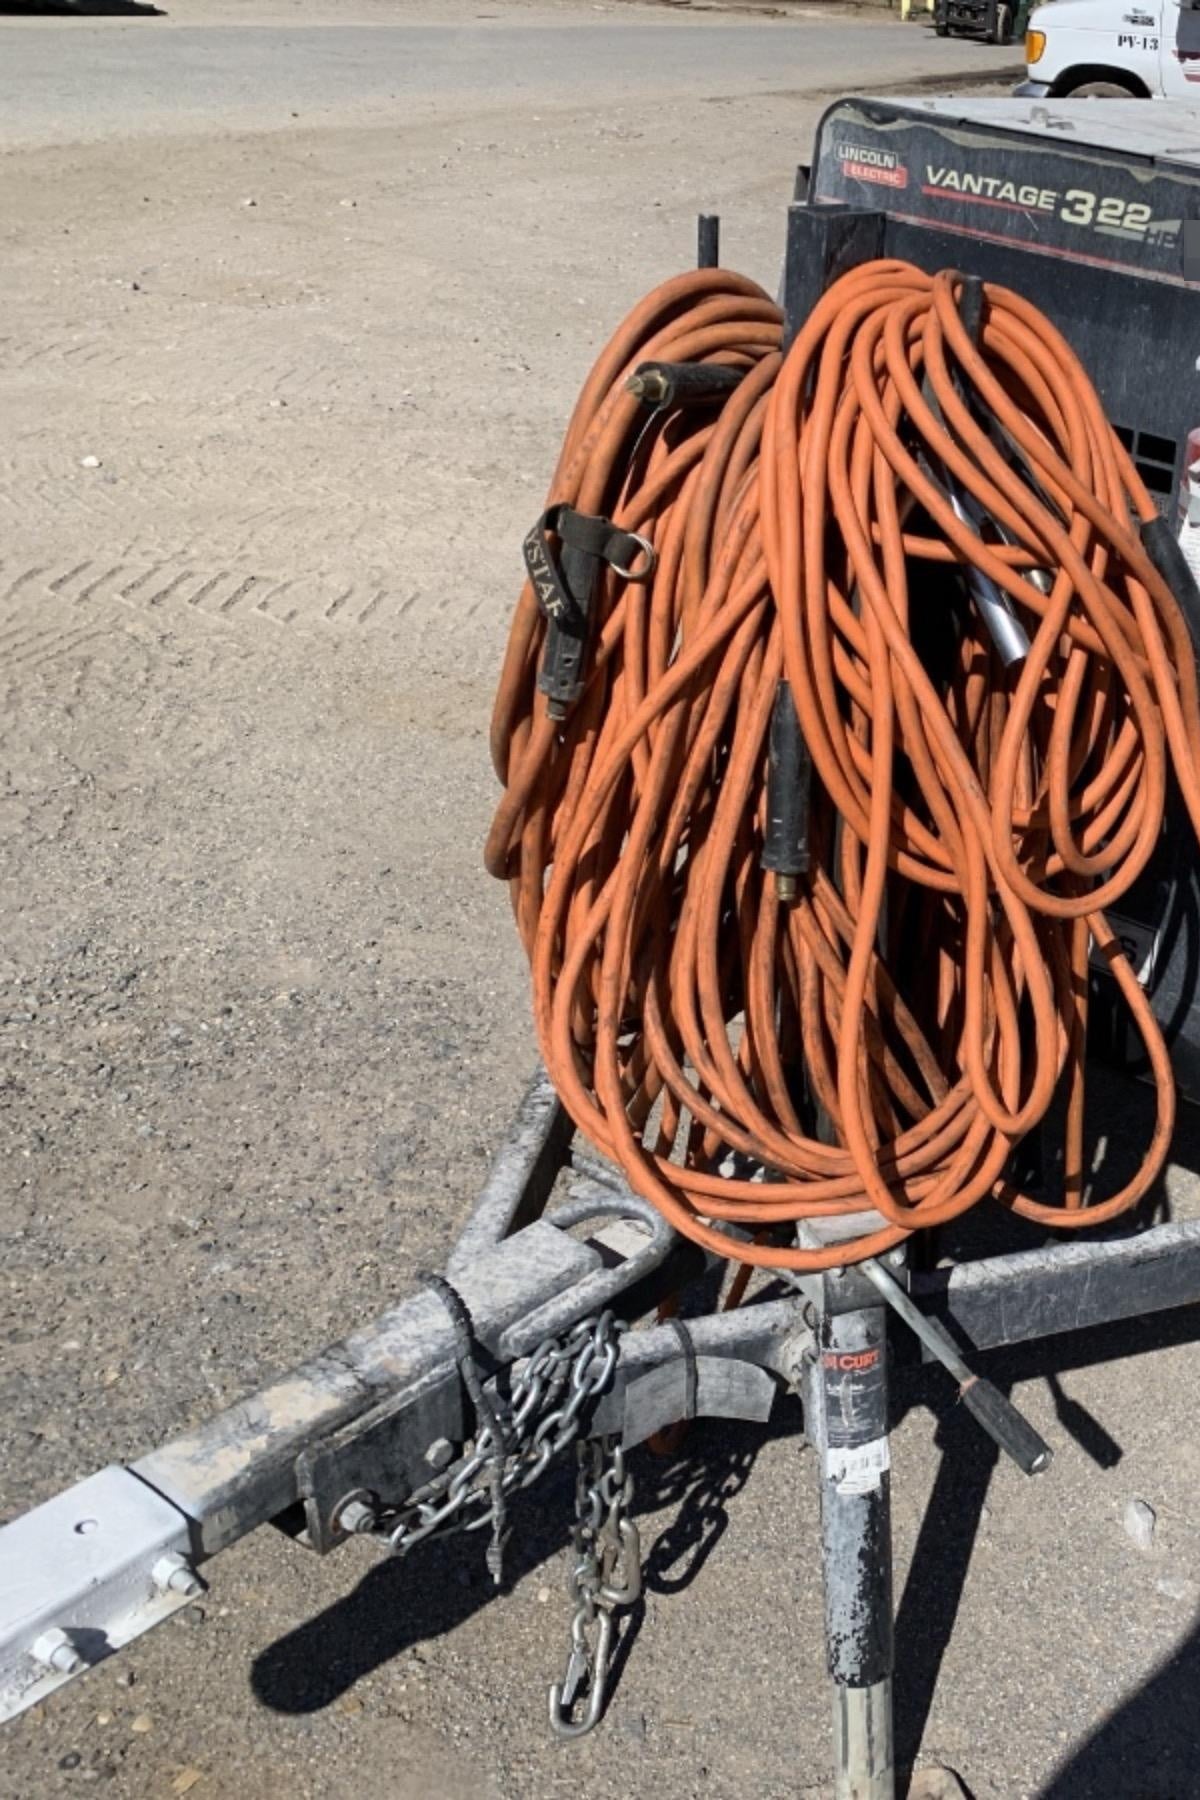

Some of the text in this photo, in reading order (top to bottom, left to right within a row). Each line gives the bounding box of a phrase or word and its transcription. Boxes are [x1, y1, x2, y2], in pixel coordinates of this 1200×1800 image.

[1117, 34, 1159, 51] PV-13
[838, 145, 895, 169] LINCOLN
[850, 166, 899, 184] ELECTRIC
[926, 165, 1057, 211] VANTAGE
[1060, 188, 1153, 232] 322
